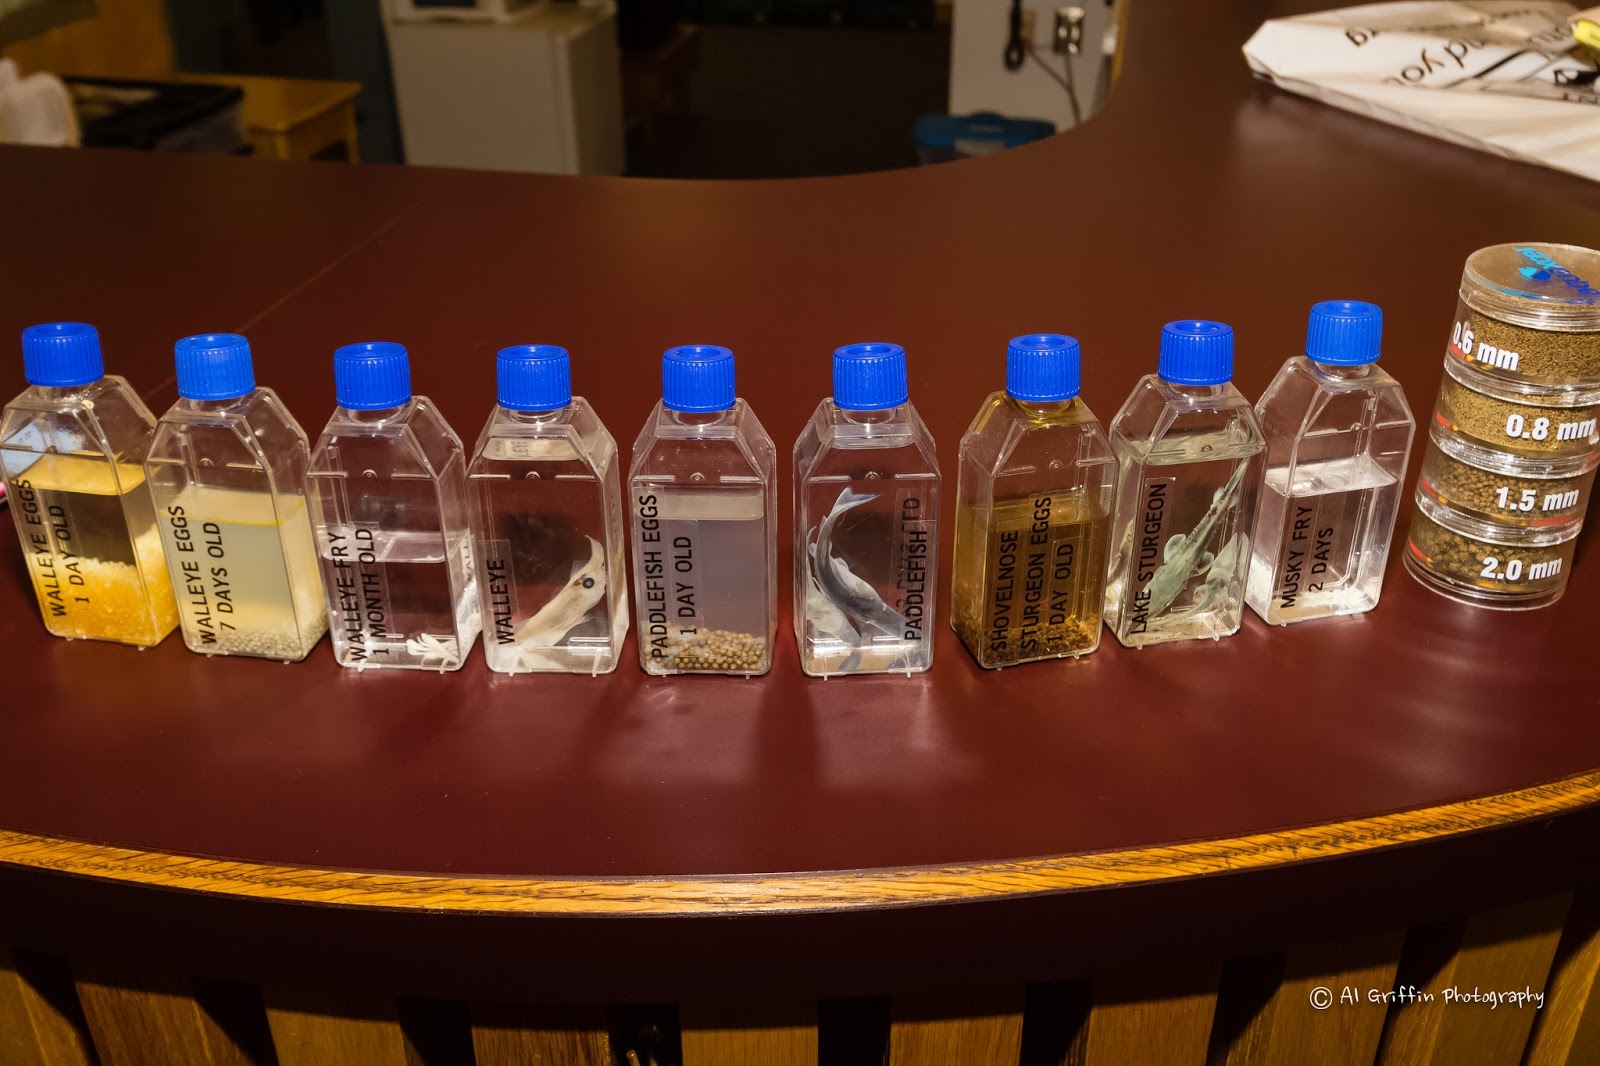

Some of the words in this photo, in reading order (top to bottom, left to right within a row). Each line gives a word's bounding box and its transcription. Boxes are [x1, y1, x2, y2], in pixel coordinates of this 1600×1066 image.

[1453, 321, 1474, 354] 0.6
[1477, 342, 1519, 371] mm
[1505, 413, 1550, 440] 0.8
[1556, 417, 1598, 440] mm
[16, 479, 42, 526] EGGS
[639, 494, 661, 544] EGGS
[1496, 486, 1537, 512] 1.5
[1542, 489, 1580, 511] mm
[48, 505, 71, 541] OLD
[167, 505, 195, 553] EGGS
[203, 522, 224, 559] OLD
[1031, 497, 1052, 550] EGGS
[1138, 483, 1168, 582] STURGEON
[1292, 506, 1312, 542] FRY
[60, 550, 85, 586] DAY
[328, 531, 352, 570] FRY
[355, 528, 376, 565] OLD
[674, 536, 693, 572] OLD
[1054, 543, 1074, 581] OLD
[1311, 527, 1334, 575] DAYS
[30, 534, 67, 617] WALLEYE
[904, 529, 928, 641] PADDLEFISH
[1281, 550, 1304, 609] MUSKY
[1309, 581, 1324, 592] 2
[1480, 556, 1523, 581] 2.0
[1528, 558, 1562, 580] mm
[74, 596, 90, 605] 1
[181, 560, 217, 645] WALLEYE
[215, 566, 234, 615] DAYS
[362, 571, 386, 639] MONTH
[486, 558, 516, 645] WALLEYE
[644, 551, 669, 658] PADDLEFISH
[676, 582, 696, 618] DAY
[991, 530, 1018, 651] SHOVELNOSE
[1021, 553, 1045, 651] STURGEON
[1049, 590, 1069, 632] DAY
[1130, 589, 1152, 634] LAKE
[220, 621, 236, 632] 7
[339, 576, 366, 662] WALLEYE
[680, 627, 698, 636] 1
[1046, 634, 1063, 645] 1
[373, 648, 389, 656] 1
